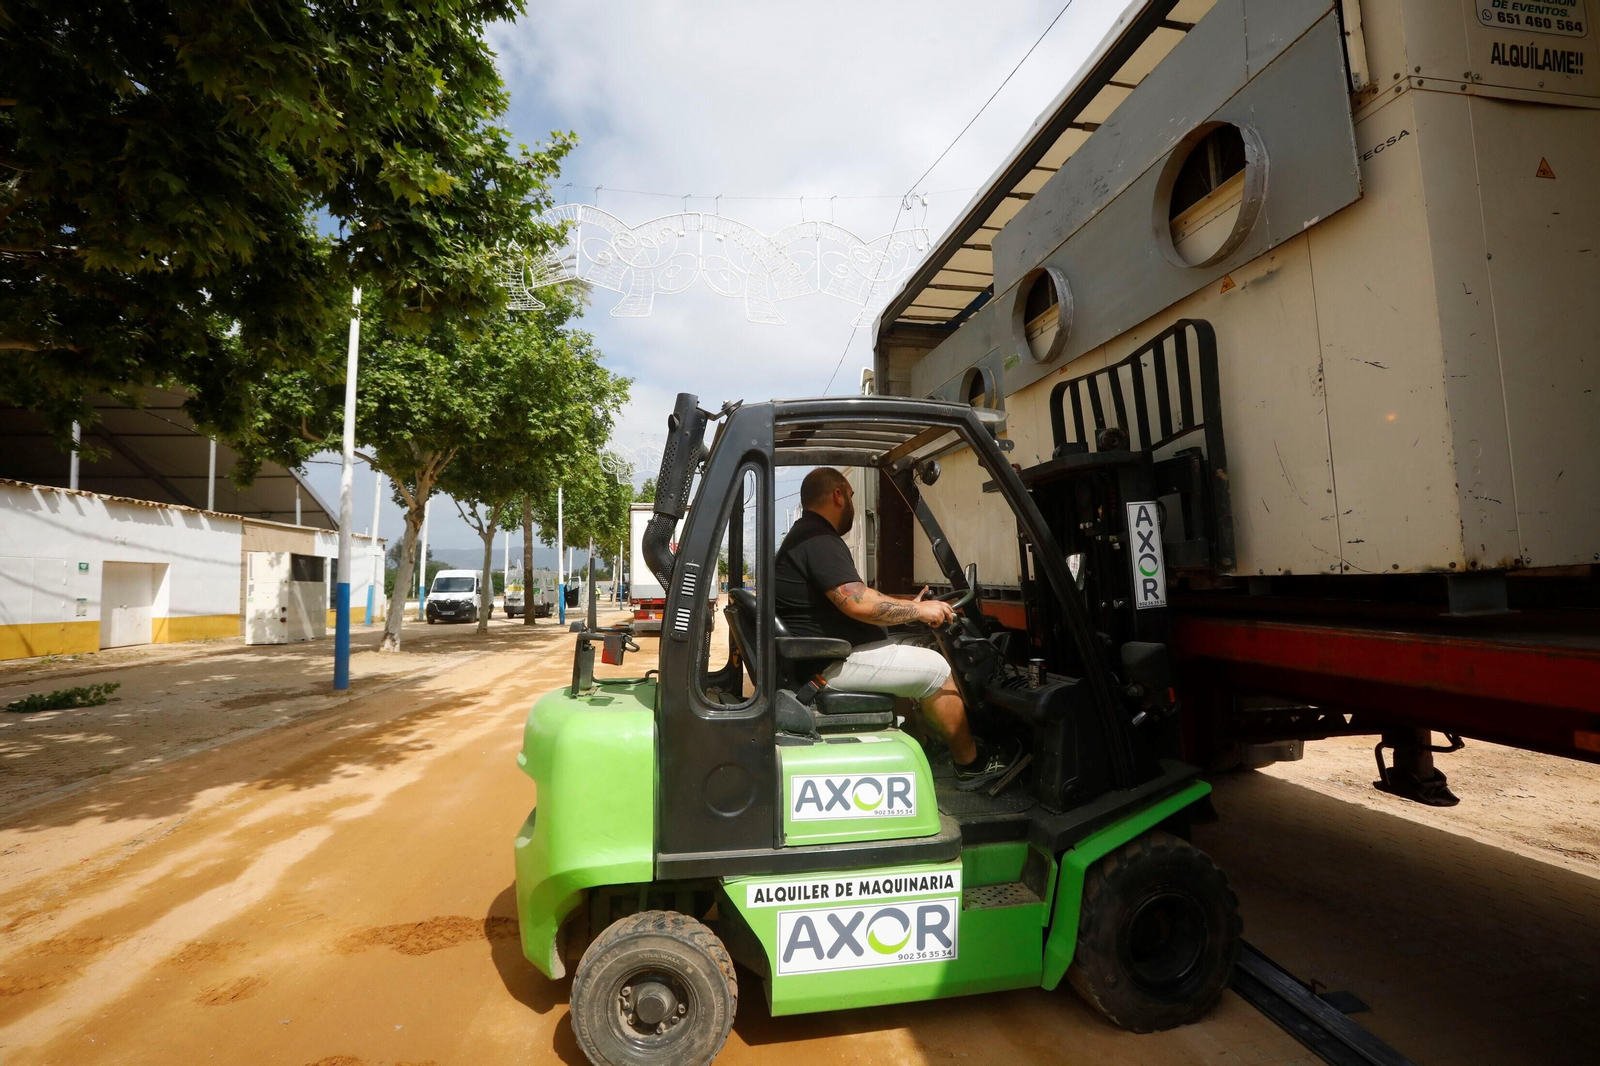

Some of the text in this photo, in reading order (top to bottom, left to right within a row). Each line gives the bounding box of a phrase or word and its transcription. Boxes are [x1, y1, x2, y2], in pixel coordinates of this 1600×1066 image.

[1492, 0, 1570, 17] DE EVENTOS.
[1497, 11, 1583, 33] 651 460 564
[1491, 41, 1584, 75] ALQUÍLAME!!
[1135, 504, 1159, 601] AXOR
[795, 776, 913, 813] AXOR
[753, 874, 954, 904] ALQUILER DE MAQUINARIA
[782, 904, 953, 964] AXOR
[916, 951, 927, 959] 36
[929, 950, 940, 958] 35
[941, 949, 952, 957] 34
